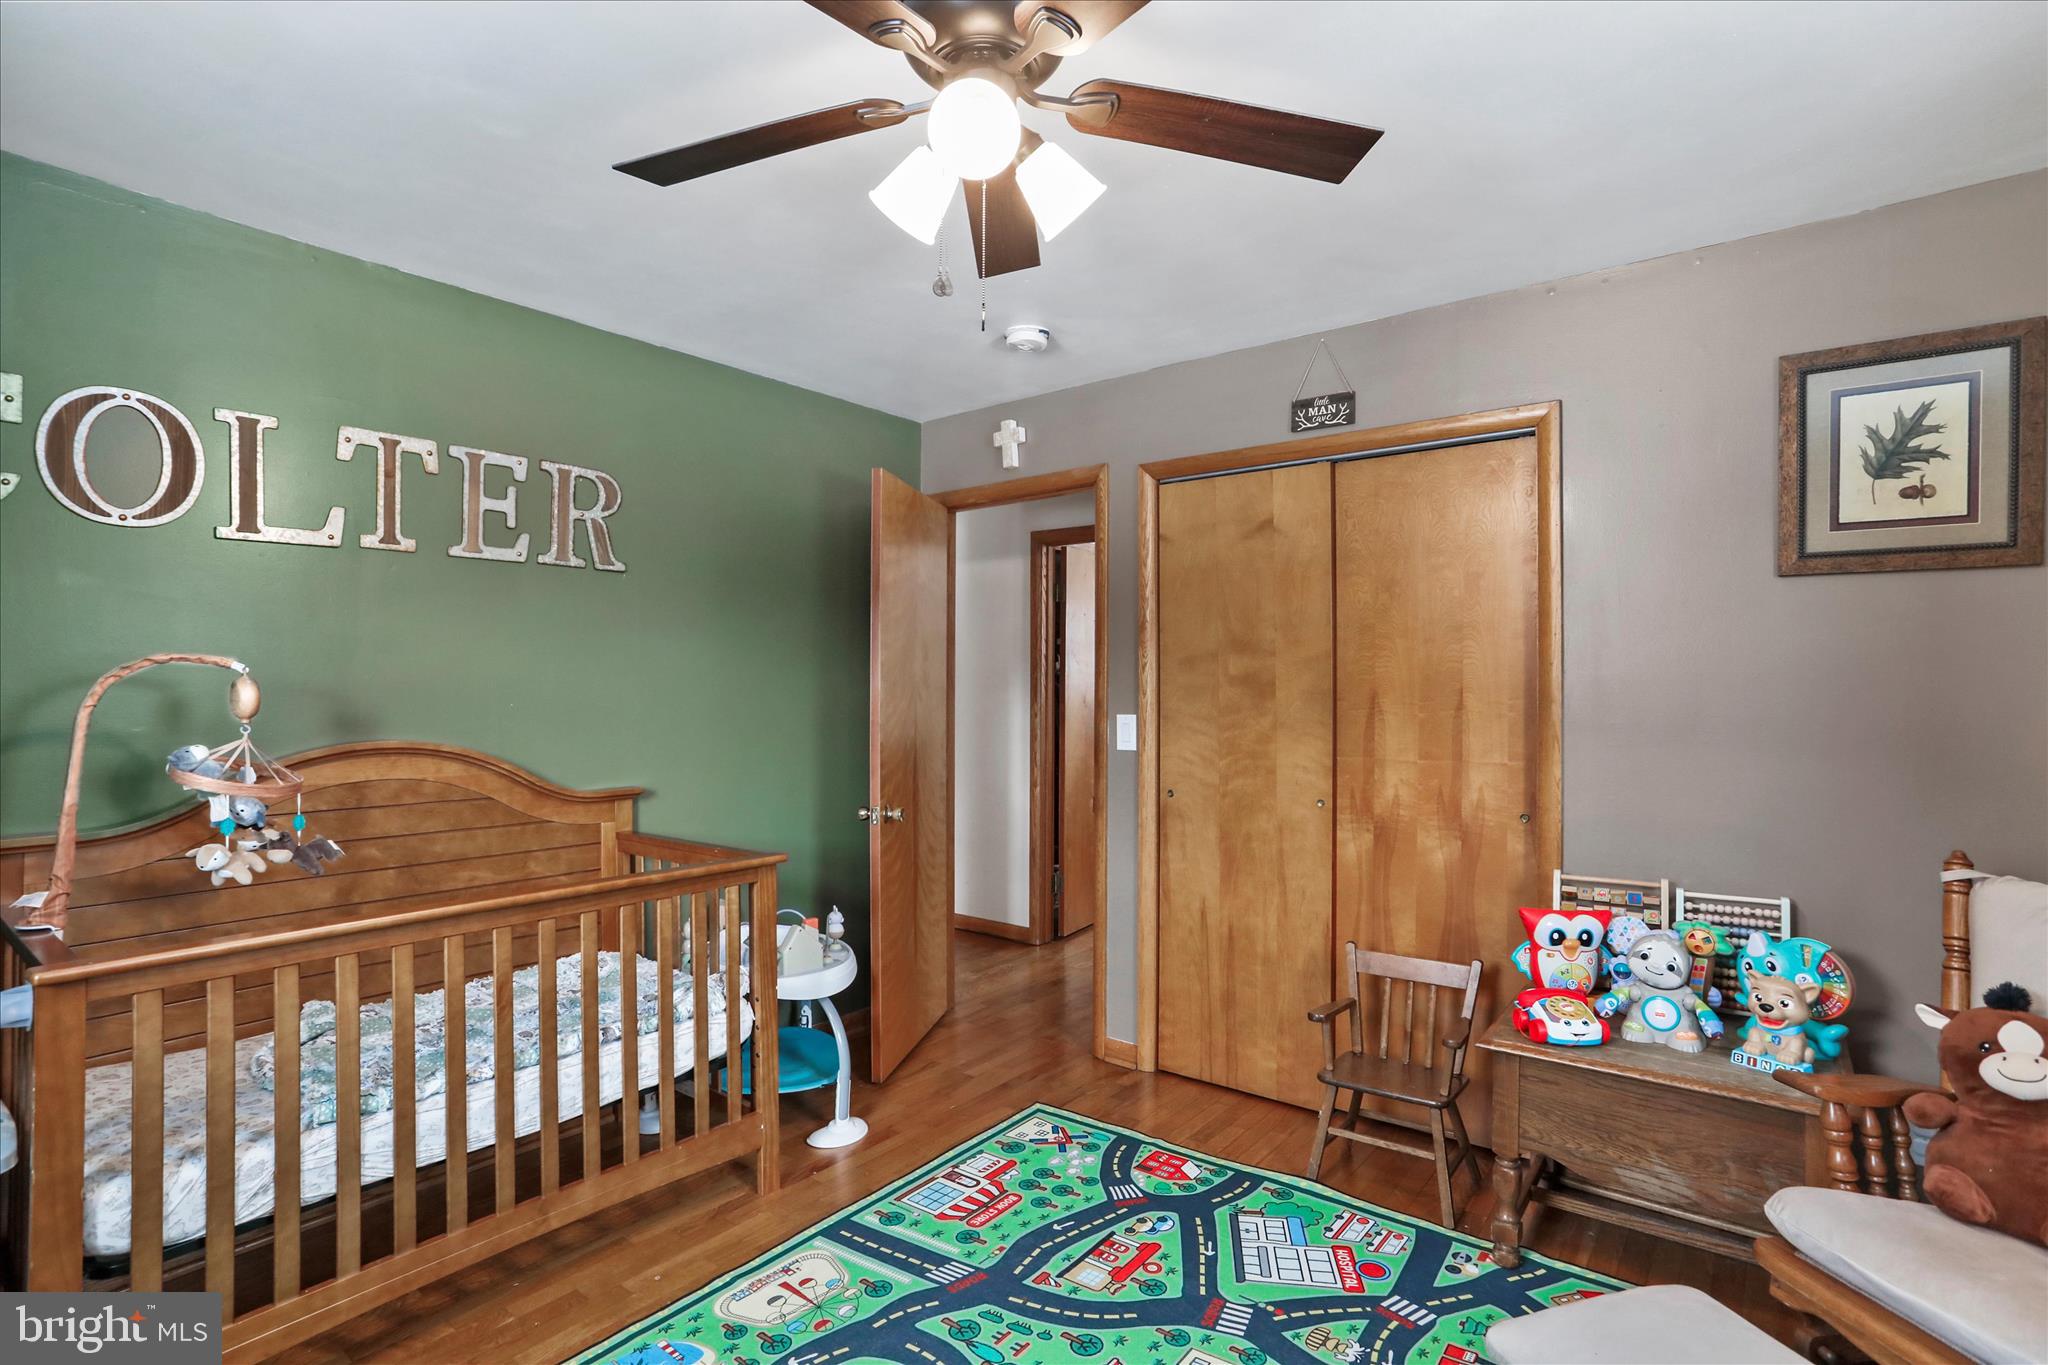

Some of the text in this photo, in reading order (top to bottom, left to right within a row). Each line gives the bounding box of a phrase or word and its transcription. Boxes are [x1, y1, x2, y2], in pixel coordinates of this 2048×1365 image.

[1308, 404, 1337, 417] MAN
[1312, 413, 1333, 423] cave
[0, 371, 627, 573] OLTER
[970, 1194, 1019, 1226] BOOK STORE
[1335, 1249, 1358, 1289] HOSPITAL
